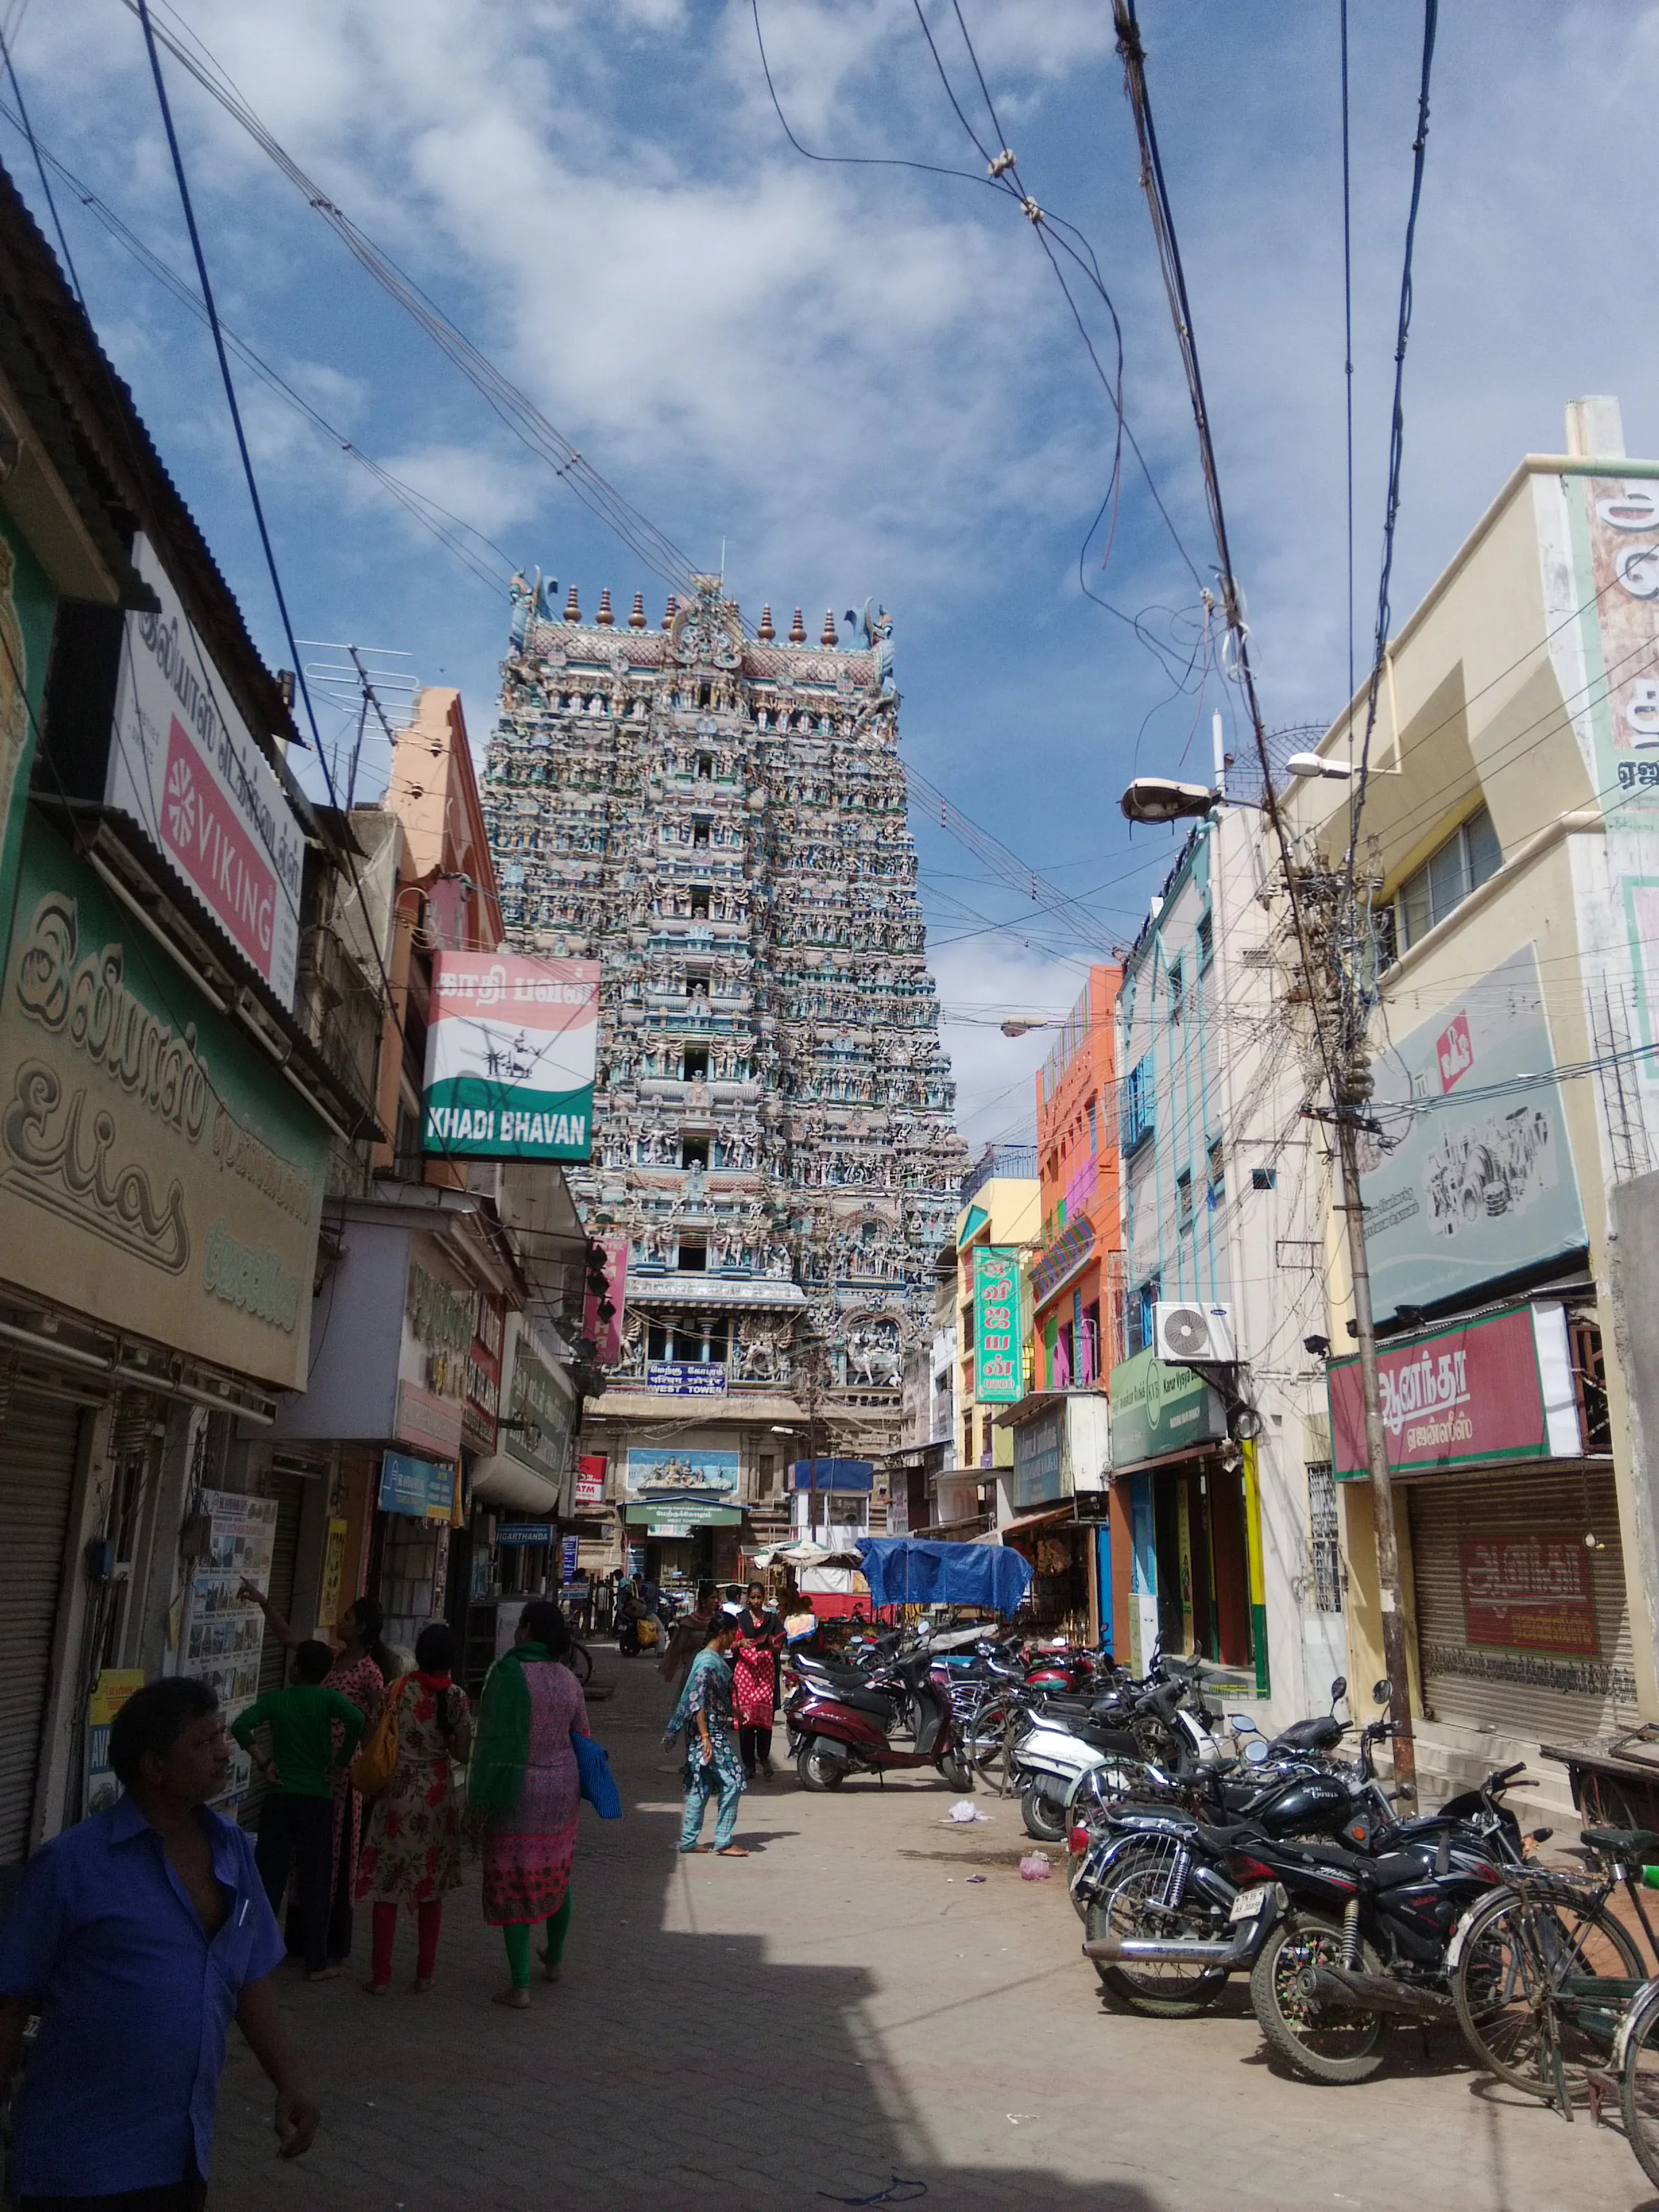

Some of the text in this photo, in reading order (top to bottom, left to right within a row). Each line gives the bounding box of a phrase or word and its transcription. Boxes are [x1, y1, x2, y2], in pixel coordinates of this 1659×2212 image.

[199, 794, 271, 951] VIKING
[436, 965, 507, 1006] காதி
[18, 893, 210, 1142] இலியாஸ்
[427, 1107, 586, 1146] KHADI BHAVAN
[1, 1059, 190, 1275] Elias
[649, 1384, 724, 1394] WEST TOWER
[576, 1485, 595, 1494] ATM
[496, 1532, 548, 1542] JIGARTHANDA
